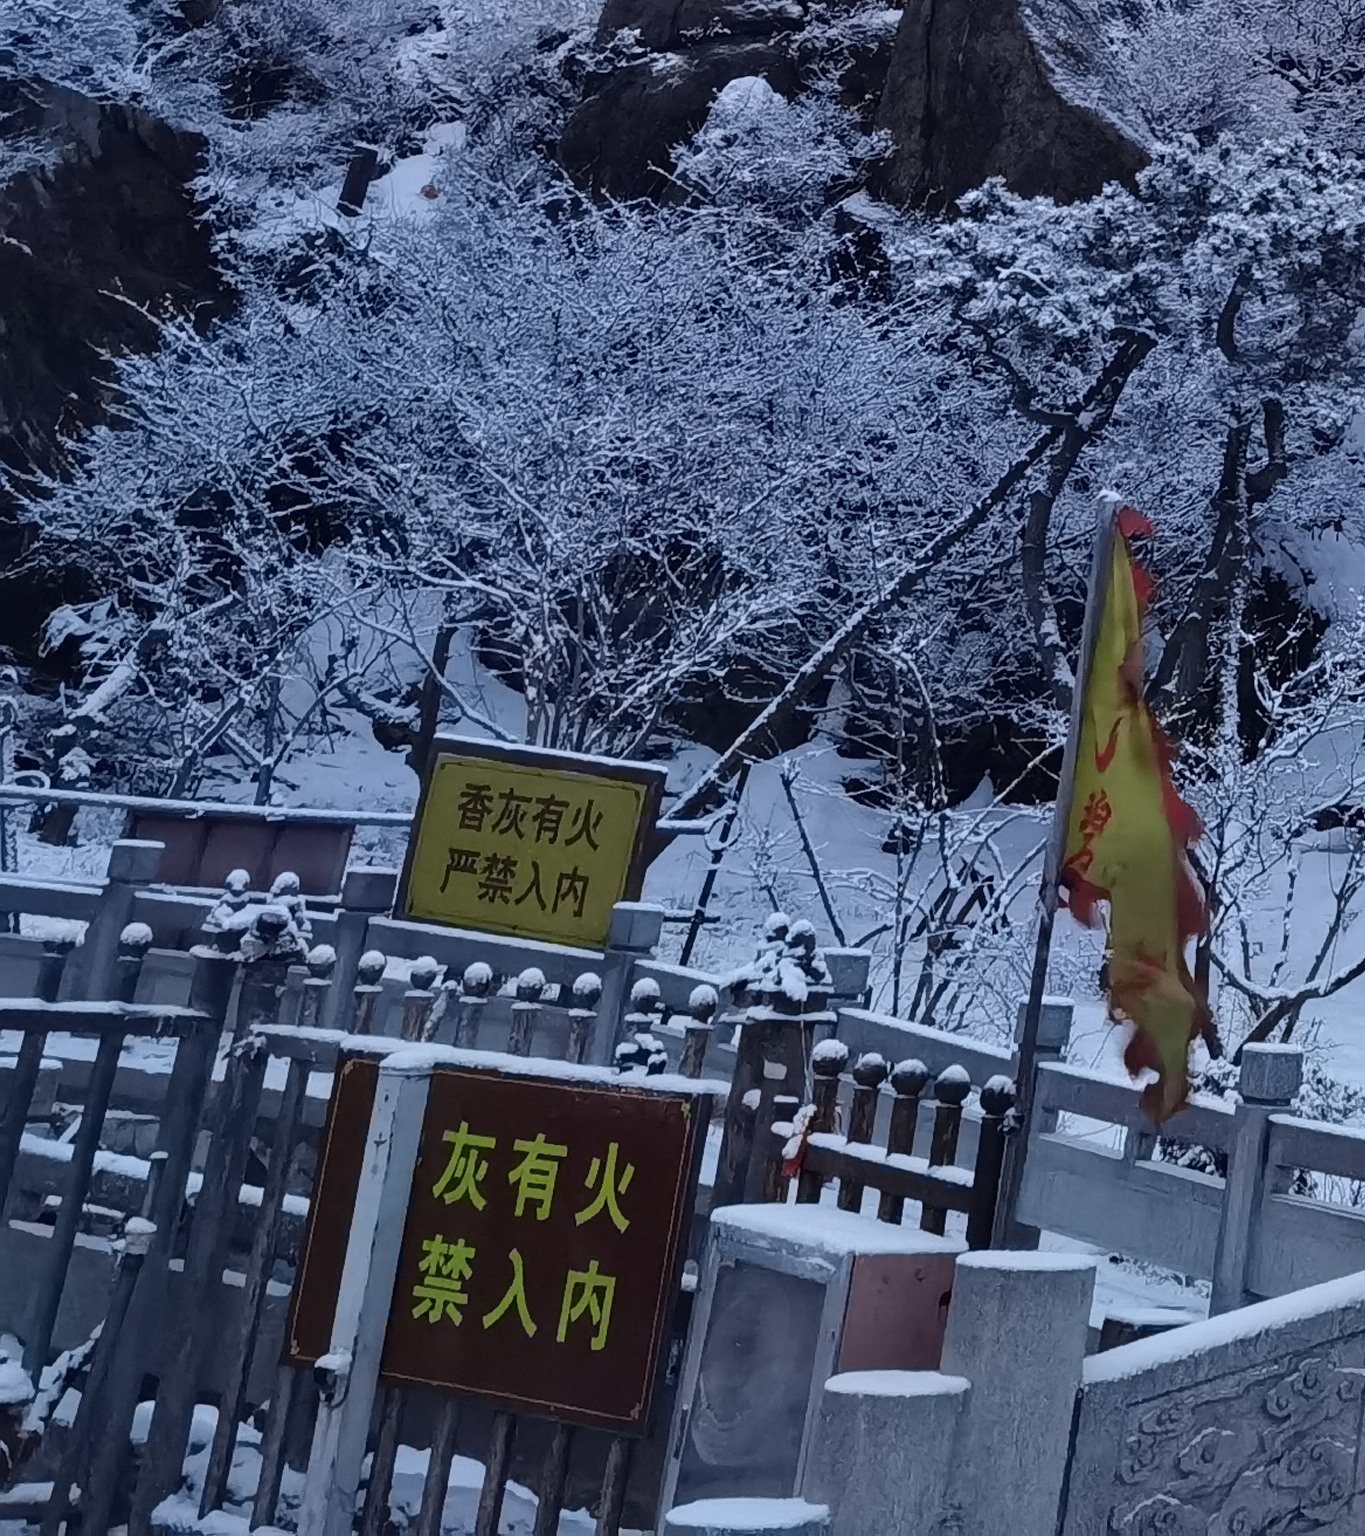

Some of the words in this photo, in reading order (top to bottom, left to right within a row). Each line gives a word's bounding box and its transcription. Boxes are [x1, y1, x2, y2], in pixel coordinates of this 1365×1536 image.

[458, 783, 604, 851] 香灰有火
[440, 848, 589, 917] 严禁入内
[433, 1122, 635, 1233] 灰有火
[412, 1234, 616, 1351] 禁入内
